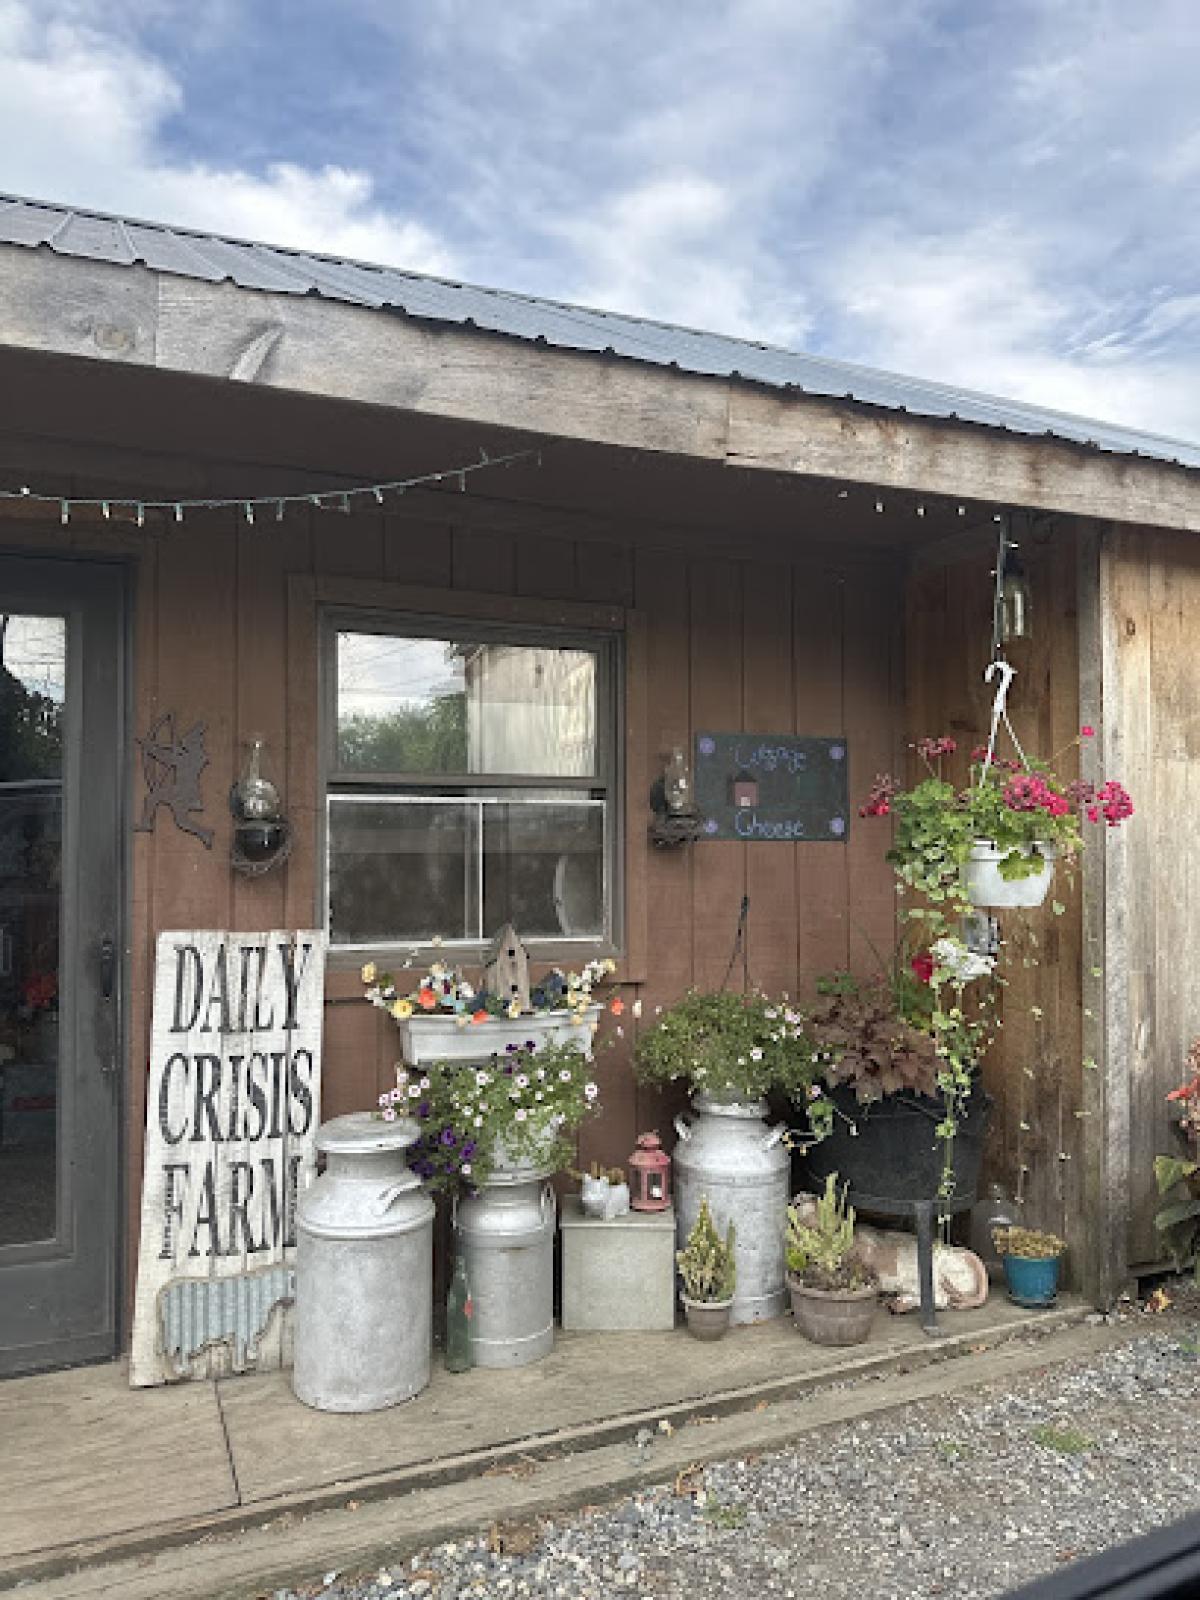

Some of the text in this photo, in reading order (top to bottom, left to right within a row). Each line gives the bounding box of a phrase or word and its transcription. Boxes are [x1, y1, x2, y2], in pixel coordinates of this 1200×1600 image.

[169, 943, 312, 1033] DAILY
[159, 1047, 312, 1144] CRISIS
[159, 1155, 303, 1260] FARM
